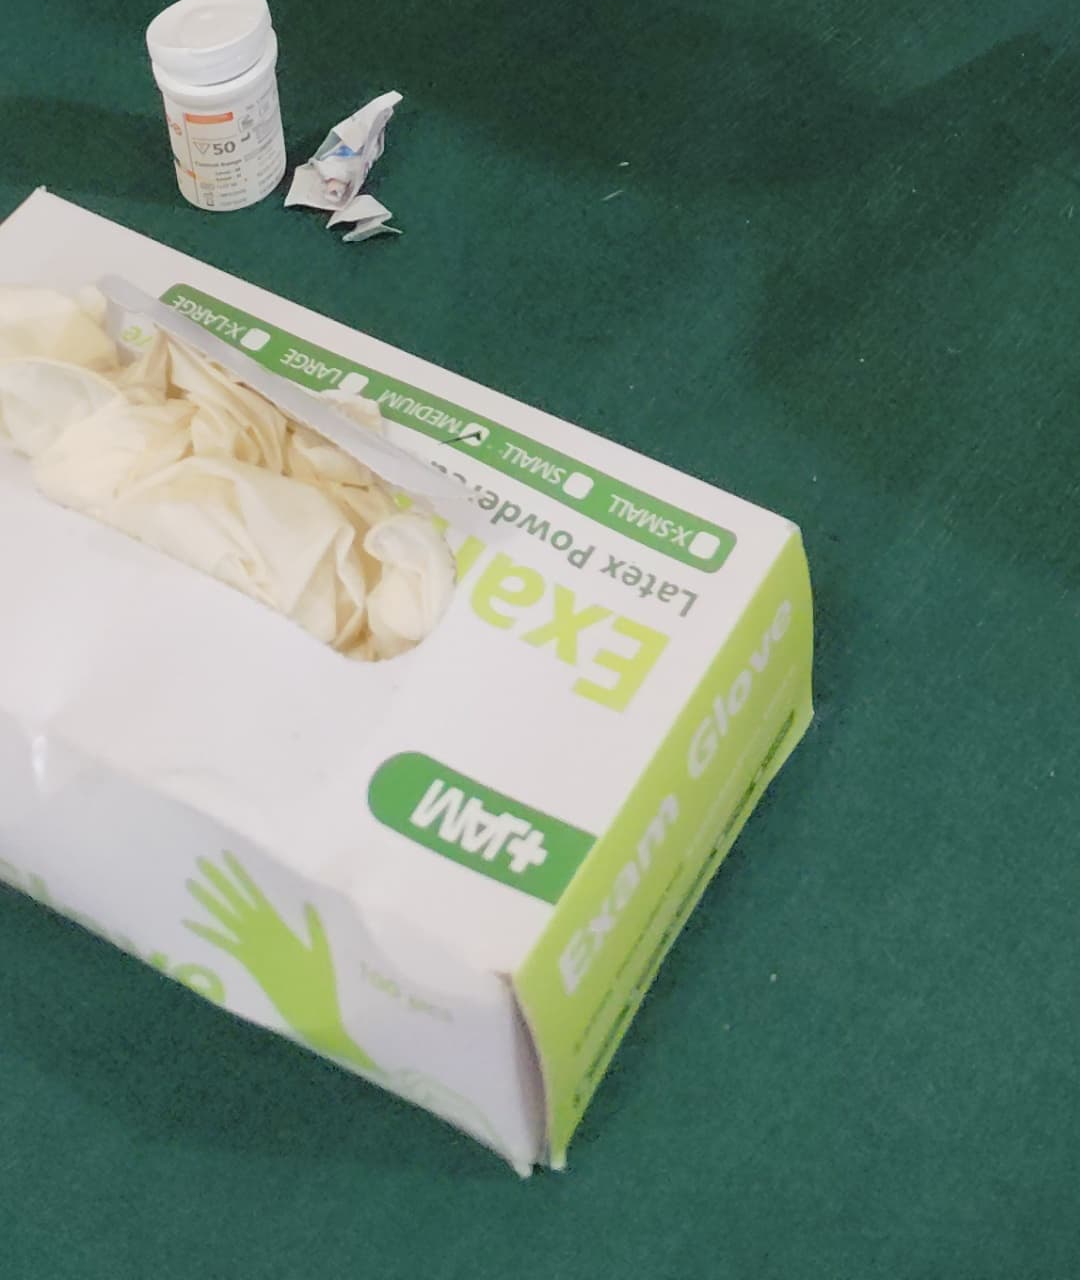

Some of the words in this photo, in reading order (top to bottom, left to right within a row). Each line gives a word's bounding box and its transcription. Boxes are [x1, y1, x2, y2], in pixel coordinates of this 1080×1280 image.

[212, 140, 236, 156] 50
[171, 295, 247, 340] X-LARGE
[279, 348, 345, 385] LARGE
[377, 389, 466, 435] MEDIUM
[501, 442, 567, 485] SMALL
[607, 493, 694, 548] X-SMALL
[600, 554, 699, 618] Latex
[557, 792, 681, 997] Exam
[686, 598, 793, 781] Glove
